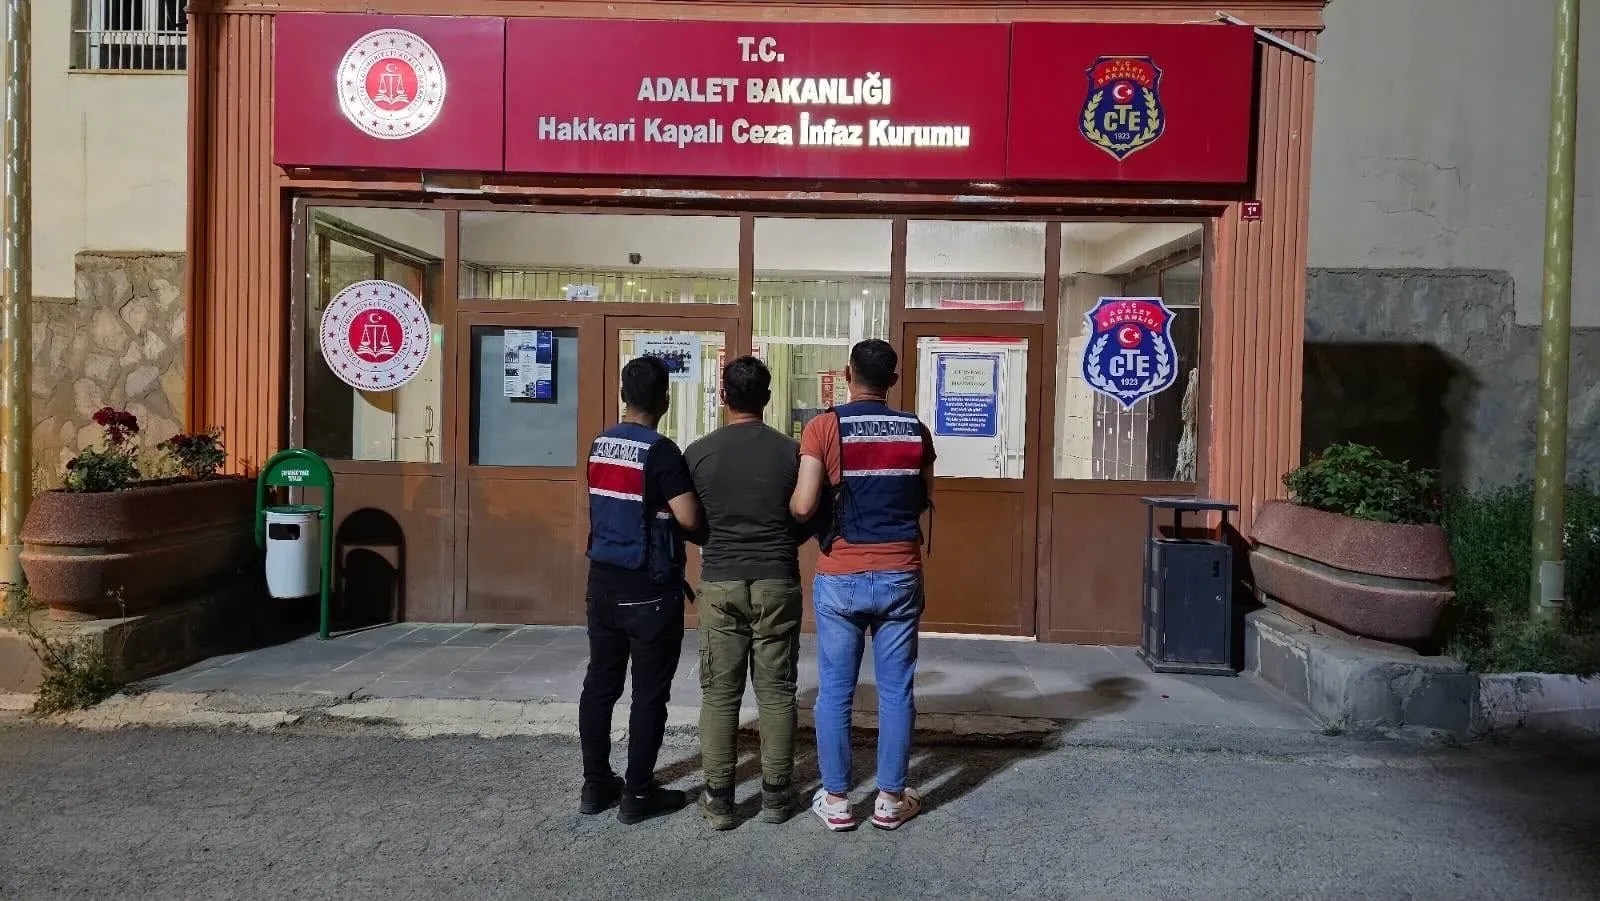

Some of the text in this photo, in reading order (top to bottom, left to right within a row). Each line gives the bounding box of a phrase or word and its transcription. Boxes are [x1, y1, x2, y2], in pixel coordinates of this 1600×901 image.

[737, 36, 785, 62] T.C.
[637, 71, 891, 105] ADALET BAKANLIĞI
[538, 111, 970, 149] Hakkari Kapalı Ceza İnfaz Kurumu
[1104, 105, 1141, 131] CTE
[1114, 132, 1130, 140] 1923
[1109, 349, 1150, 377] CTE
[1121, 378, 1138, 386] 1923
[849, 421, 915, 437] JANDARMA
